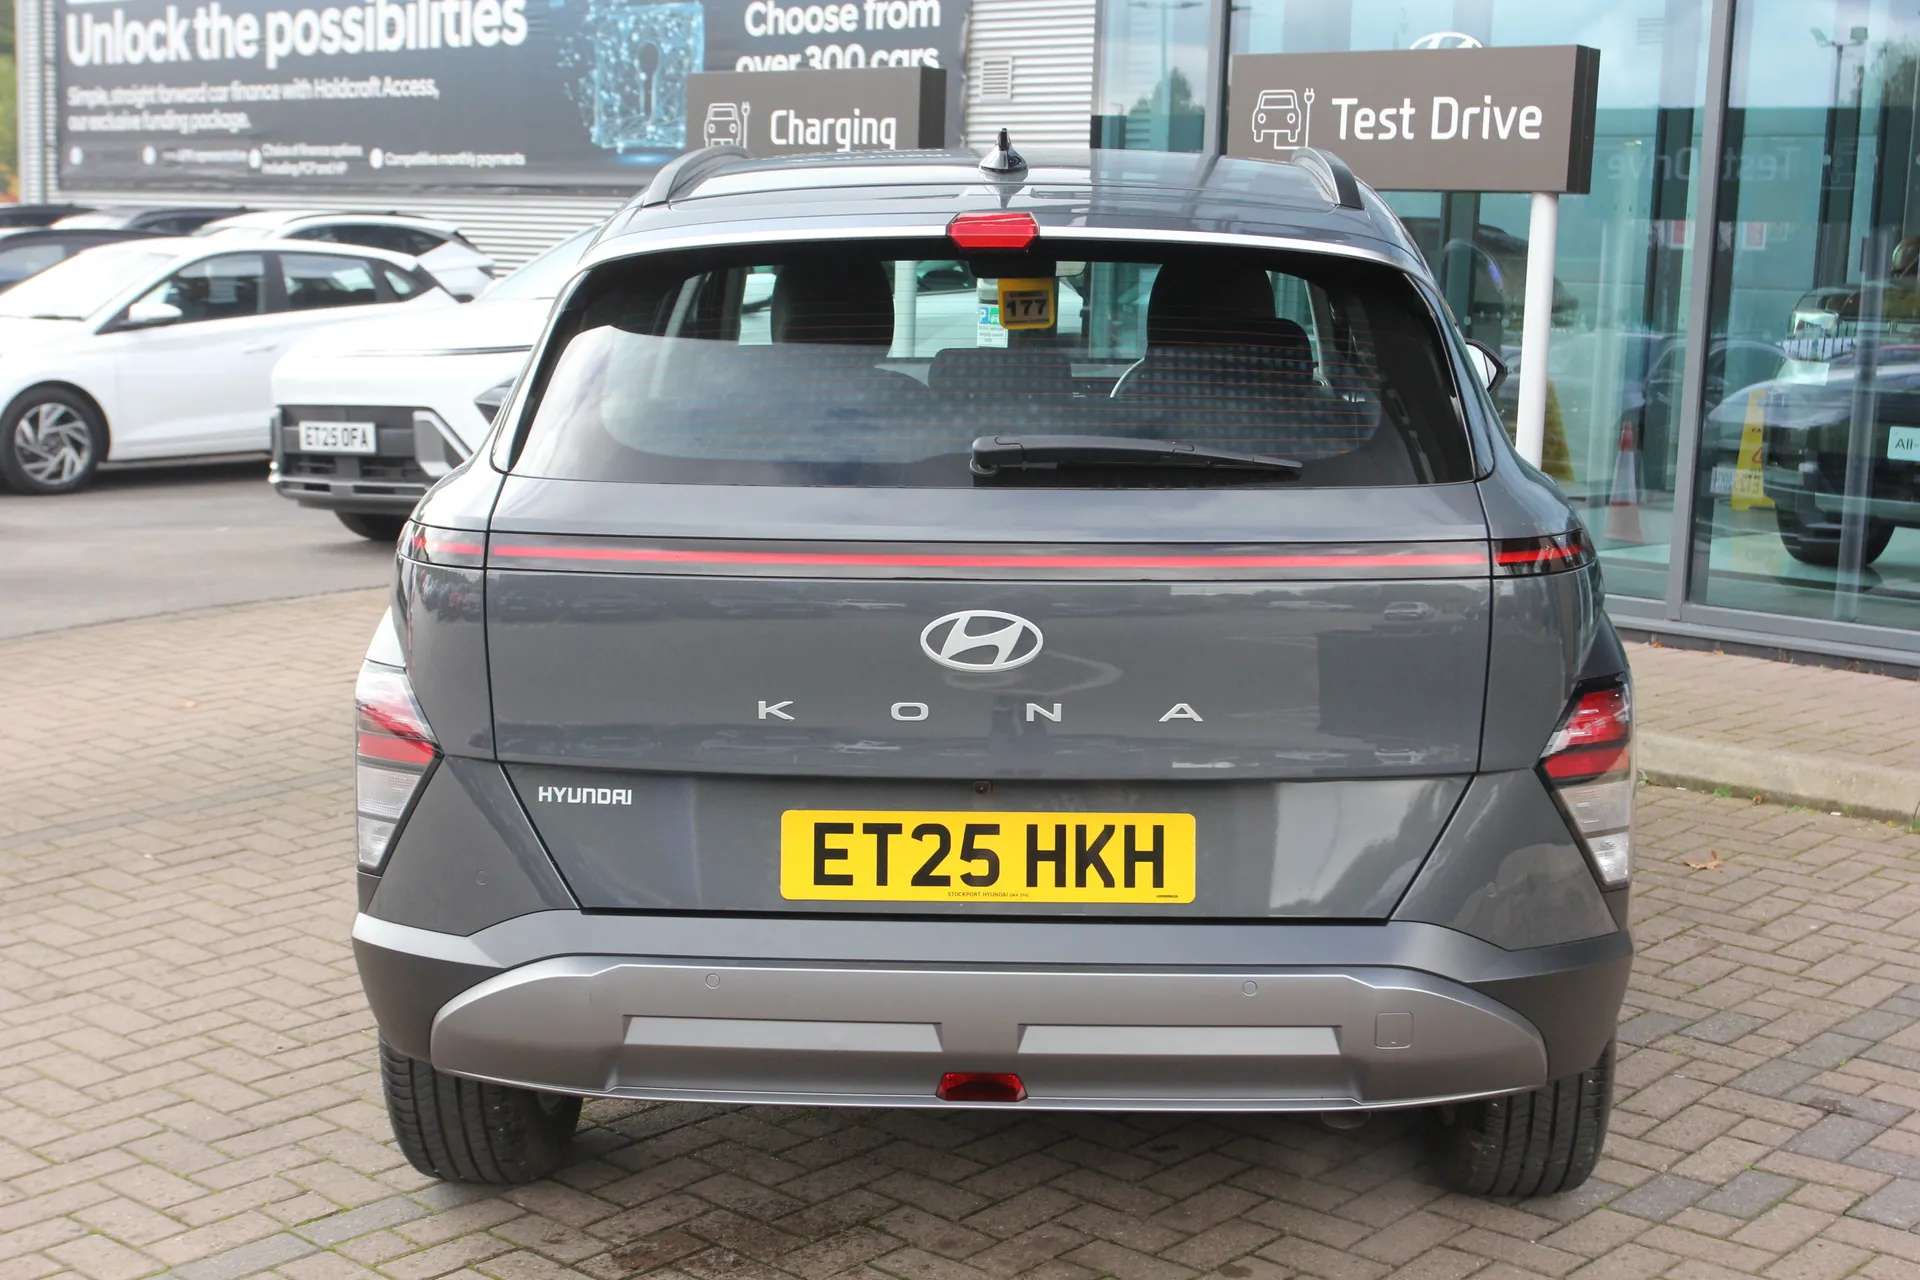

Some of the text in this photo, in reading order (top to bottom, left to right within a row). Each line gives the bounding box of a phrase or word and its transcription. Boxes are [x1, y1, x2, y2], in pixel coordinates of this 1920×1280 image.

[65, 0, 528, 70] Unlock the possibilities
[744, 0, 941, 37] Choose from
[735, 43, 940, 72] over 300 cars
[282, 77, 313, 100] with
[314, 76, 381, 99] Holdcroft
[382, 75, 440, 99] Access,
[770, 108, 897, 152] Charging
[1331, 95, 1543, 141] Test Drive
[305, 426, 338, 447] ET25
[538, 786, 633, 806] HYUNDAI
[813, 822, 1165, 889] ET25 HKH
